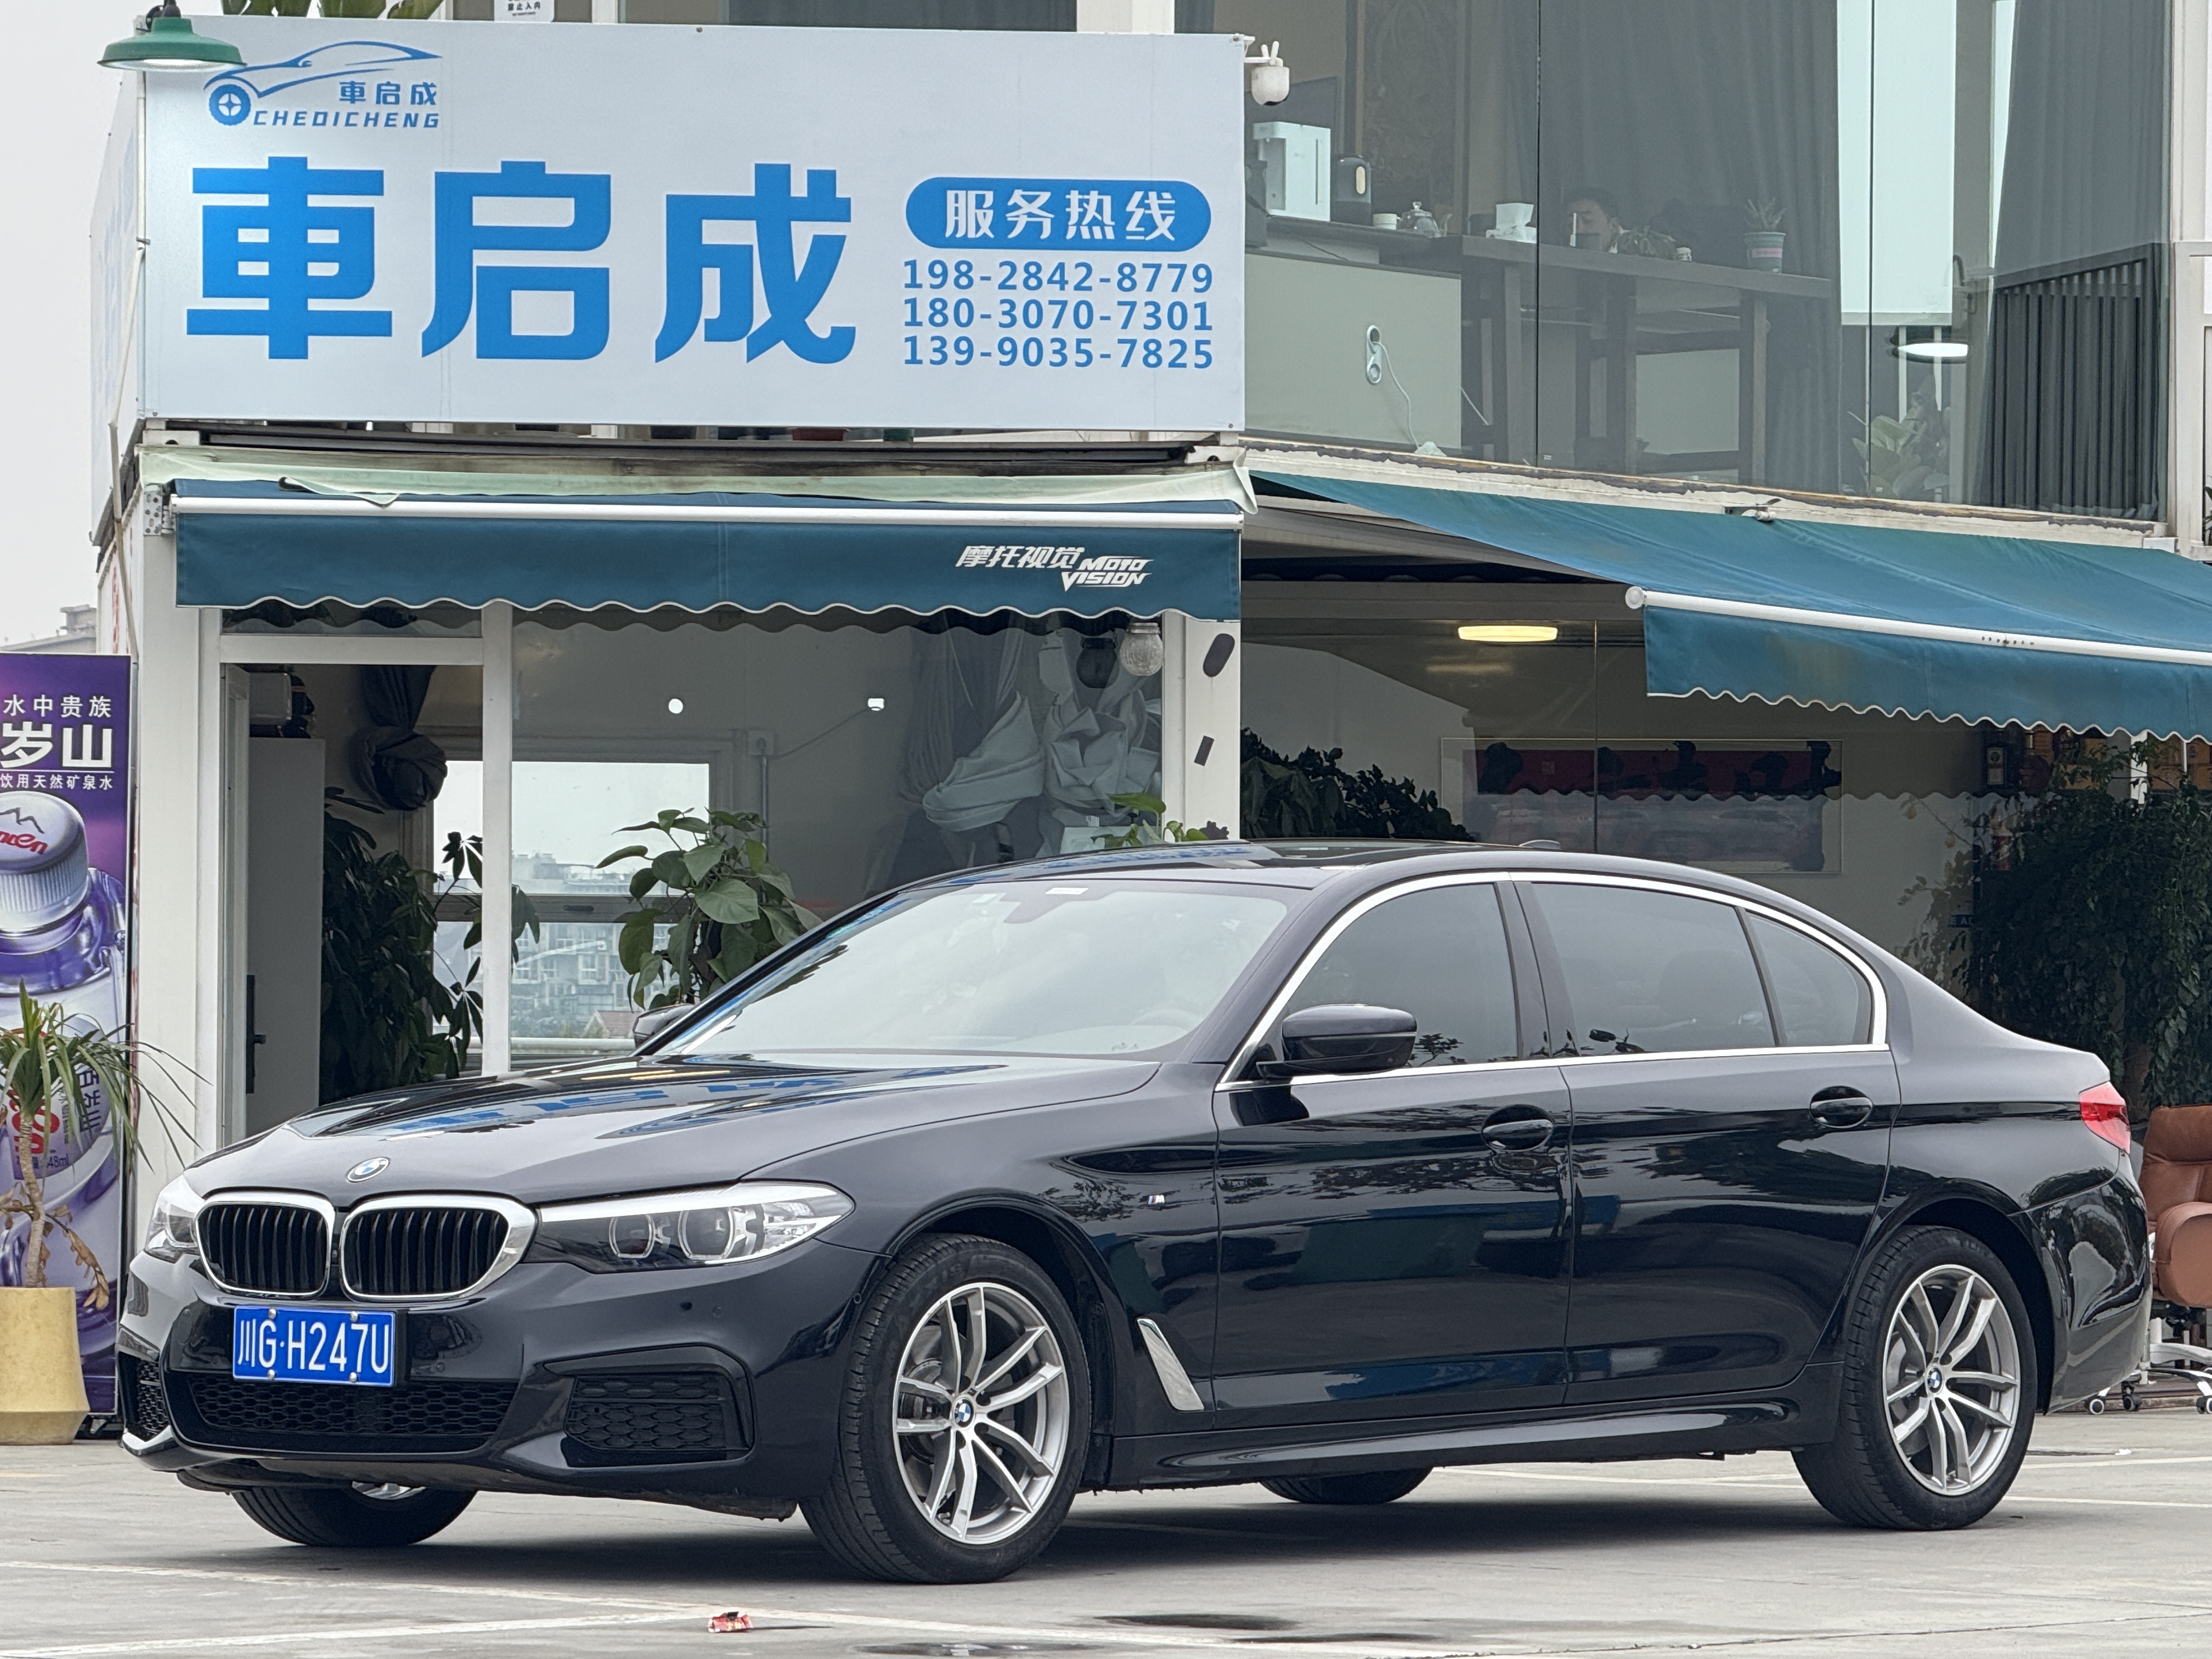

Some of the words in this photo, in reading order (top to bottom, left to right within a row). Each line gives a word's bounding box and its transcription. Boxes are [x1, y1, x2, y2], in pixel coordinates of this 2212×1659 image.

[340, 81, 437, 105] 車启成
[253, 110, 439, 128] CHEDICHENG
[945, 189, 1176, 241] 服务热线
[187, 156, 856, 365] 車启成
[904, 259, 1213, 293] 198-2842-8779
[904, 297, 1213, 331] 180-3070-7301
[904, 335, 1213, 369] 139-9035-7825
[955, 545, 1085, 568] 摩托视觉
[3, 694, 112, 718] 水中贵族
[0, 721, 112, 768] 岁山
[238, 1319, 389, 1374] 川G·H247U
